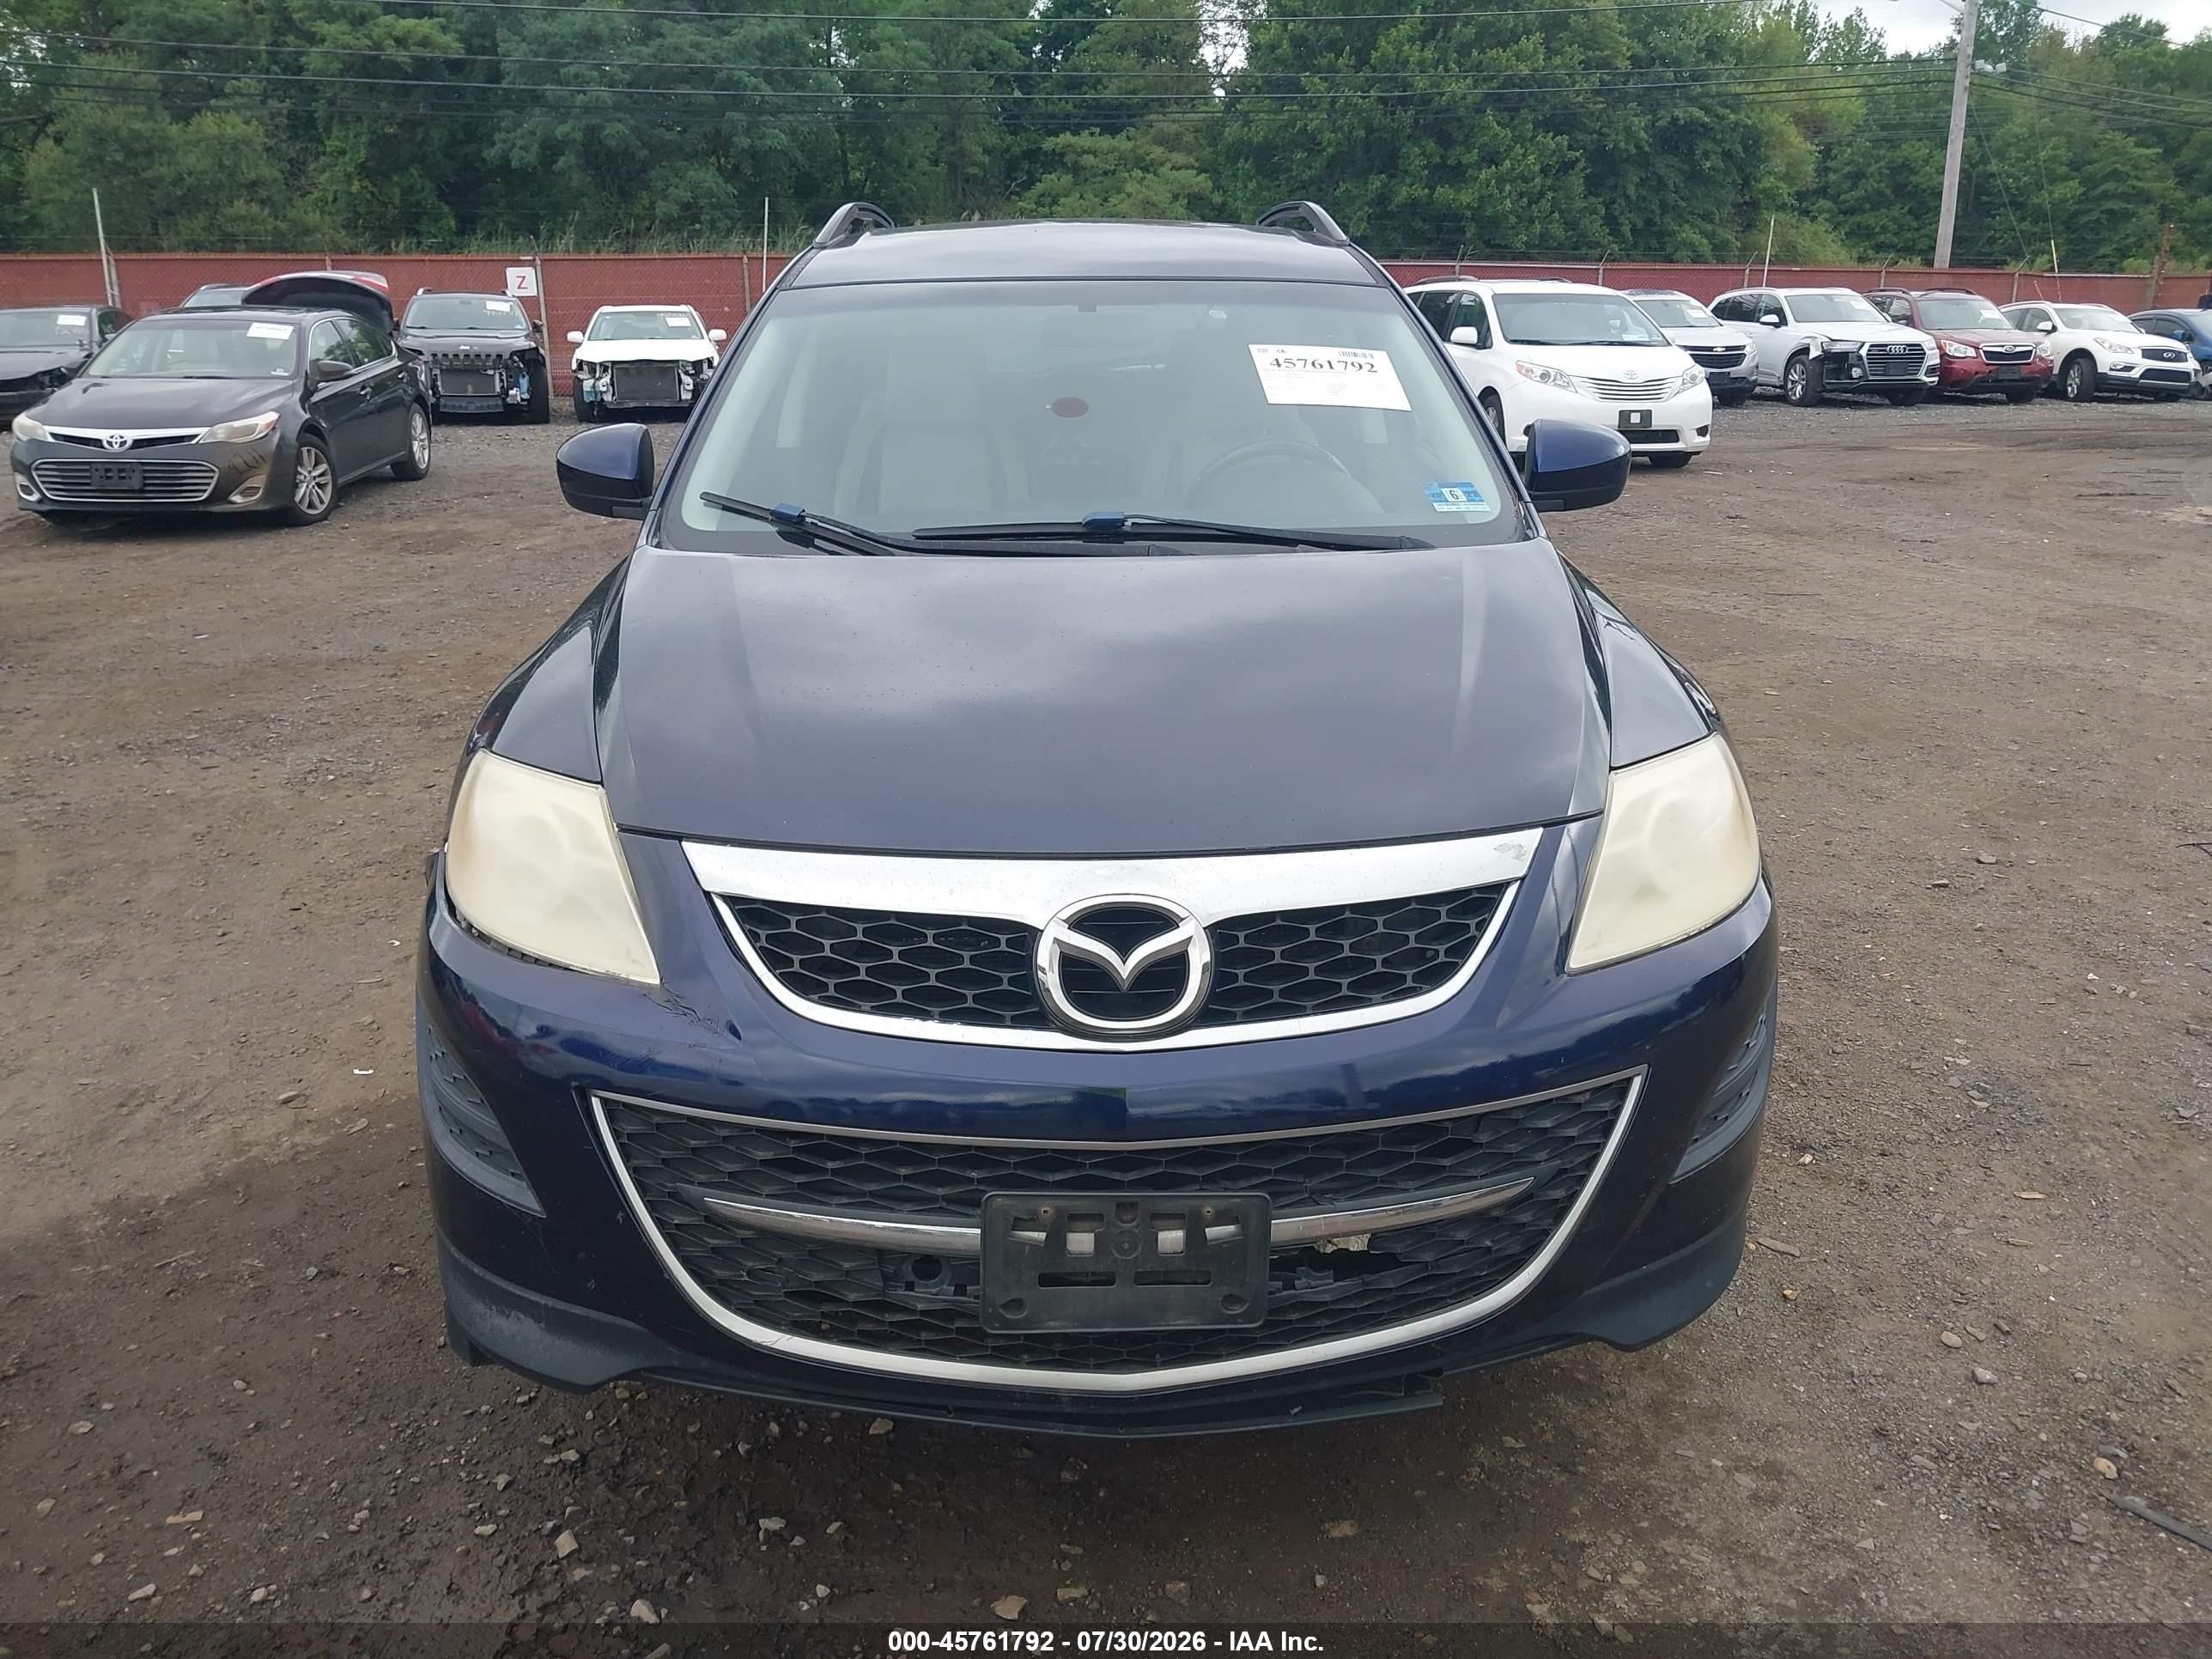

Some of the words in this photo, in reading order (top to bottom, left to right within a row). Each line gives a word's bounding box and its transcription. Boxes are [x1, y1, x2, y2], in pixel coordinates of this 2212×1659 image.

[516, 276, 528, 290] Z
[1269, 357, 1378, 374] 45761792
[1449, 489, 1460, 501] 6
